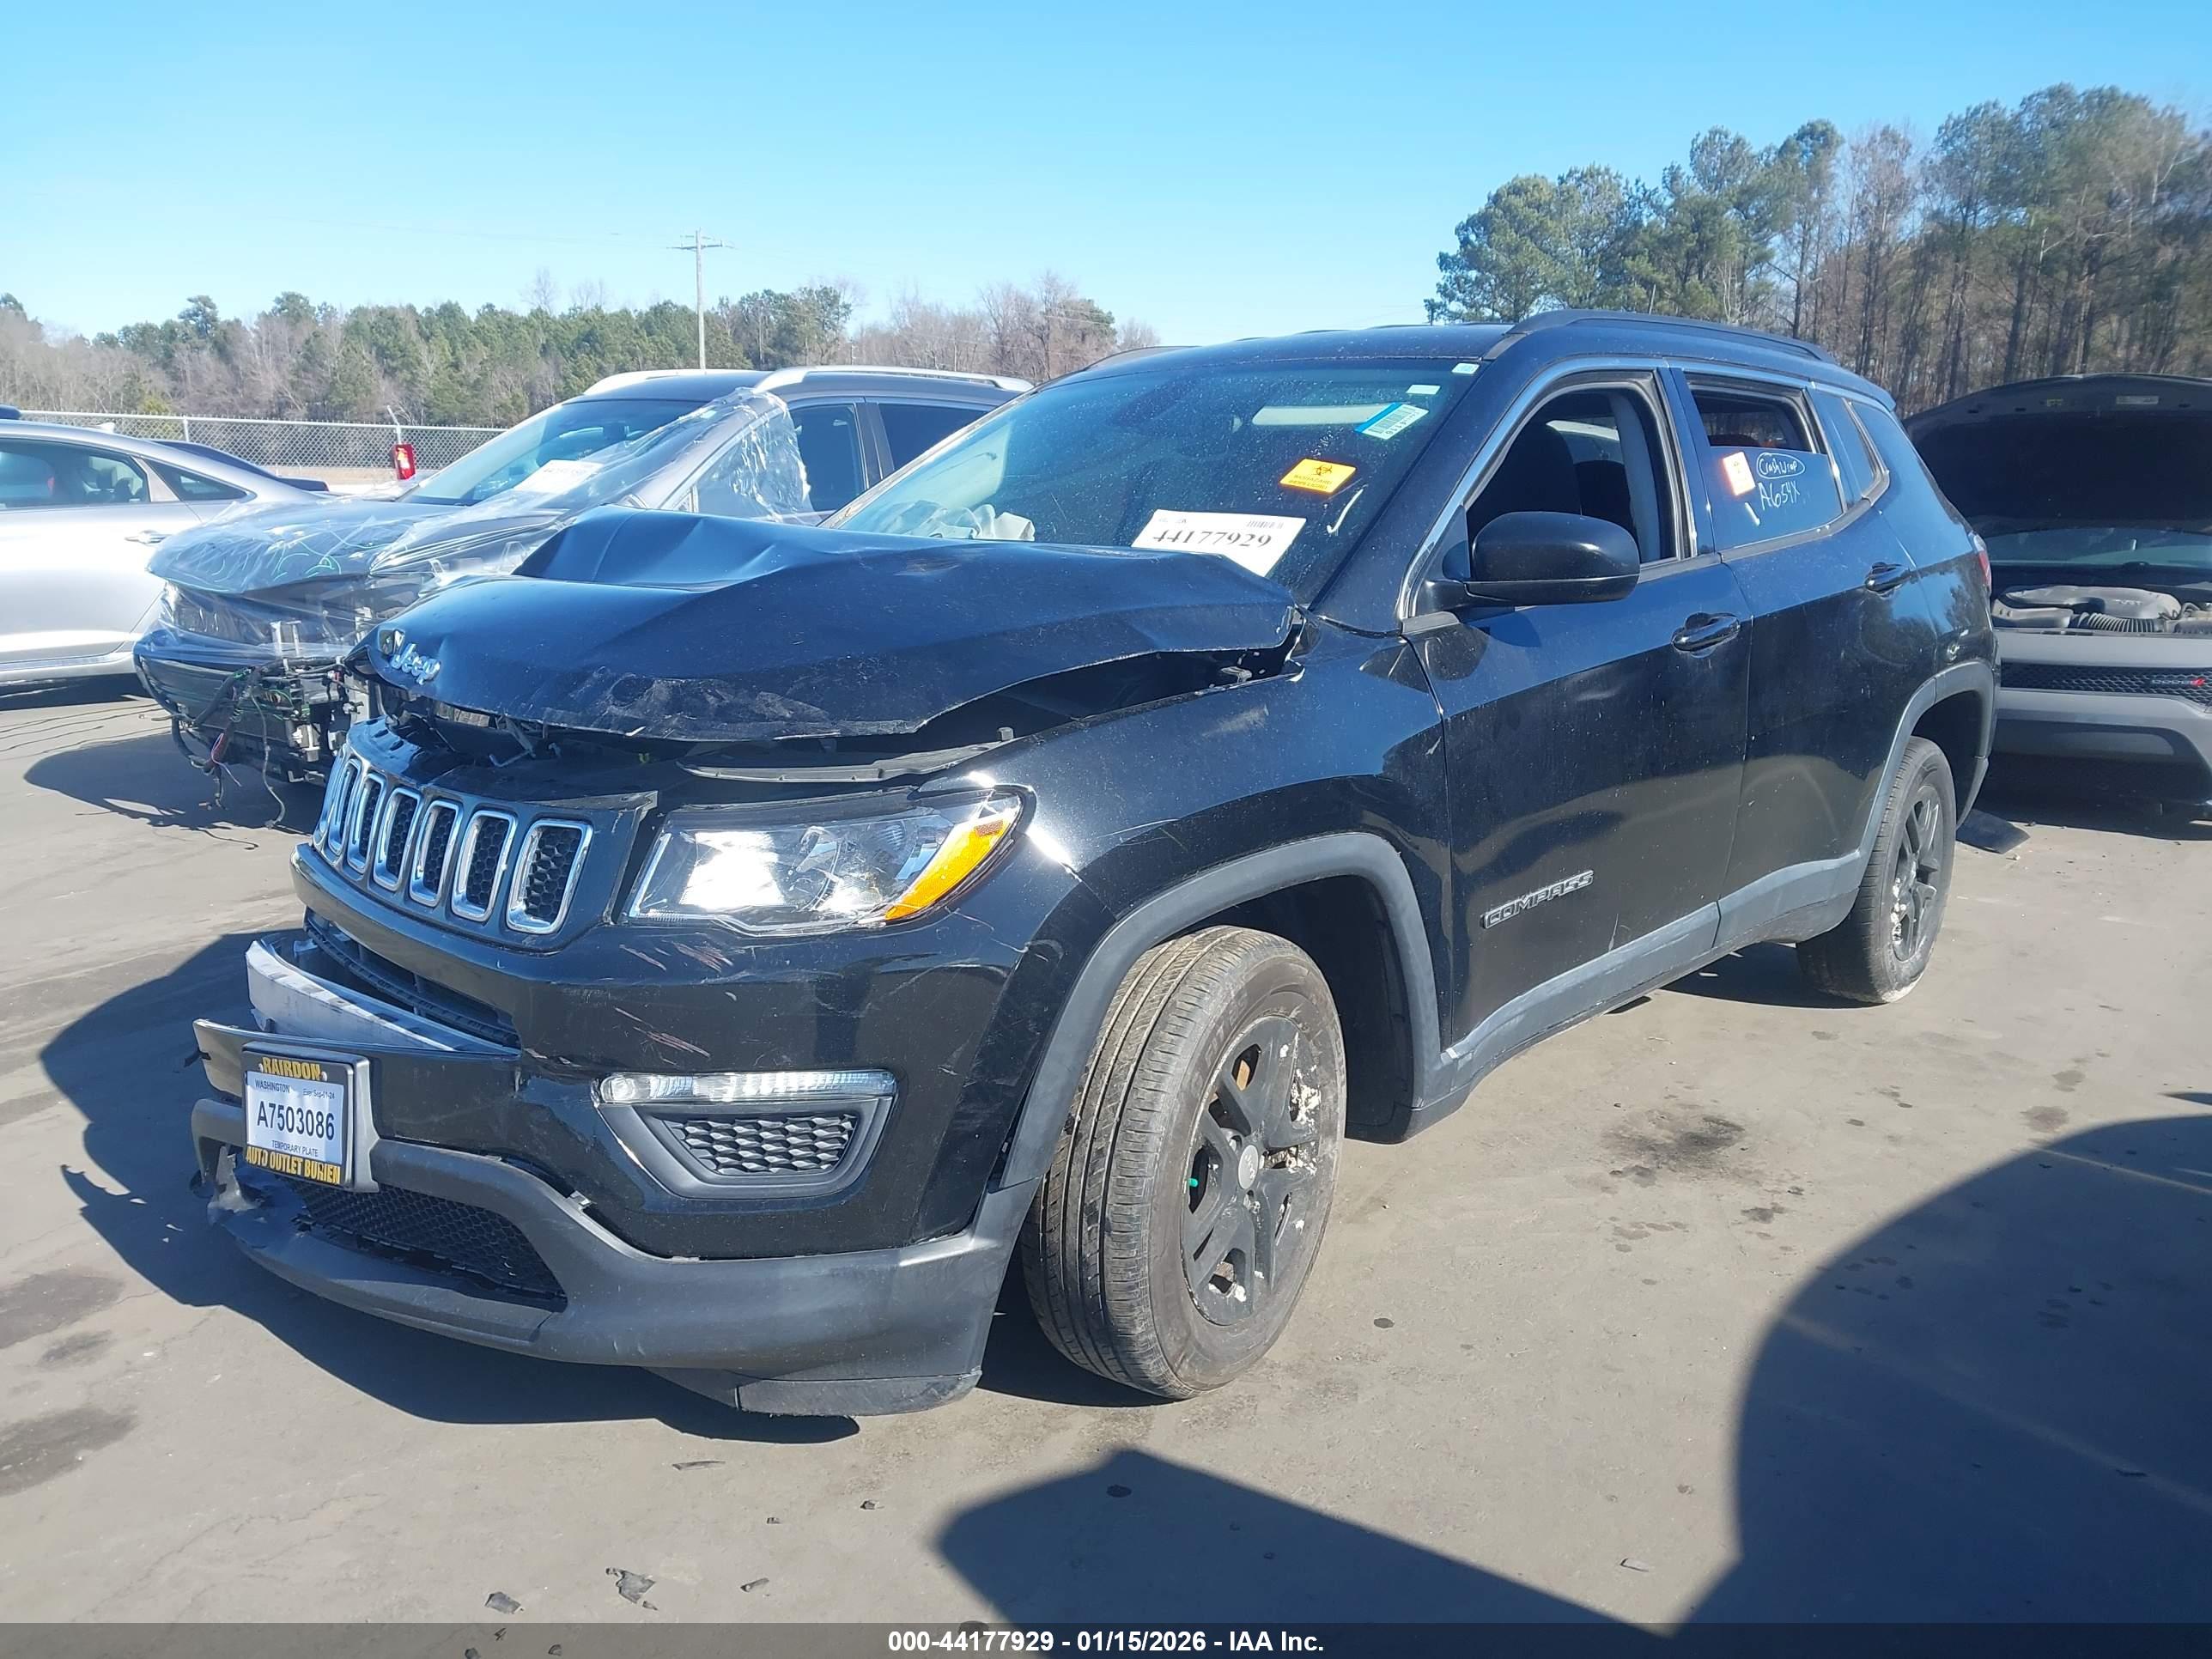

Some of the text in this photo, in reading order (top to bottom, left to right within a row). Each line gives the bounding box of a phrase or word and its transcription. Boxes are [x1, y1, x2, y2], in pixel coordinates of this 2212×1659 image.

[1152, 529, 1272, 548] 44177929
[392, 643, 441, 685] Jeep
[1485, 869, 1594, 928] COMPASS
[262, 1057, 321, 1080] RAIRDON
[254, 1079, 290, 1094] WASHINGTON
[257, 1101, 335, 1140] A7503086
[271, 1140, 319, 1157] TEMPORARY PLATE
[246, 1146, 341, 1184] AUTO OUTLET BURIEN
